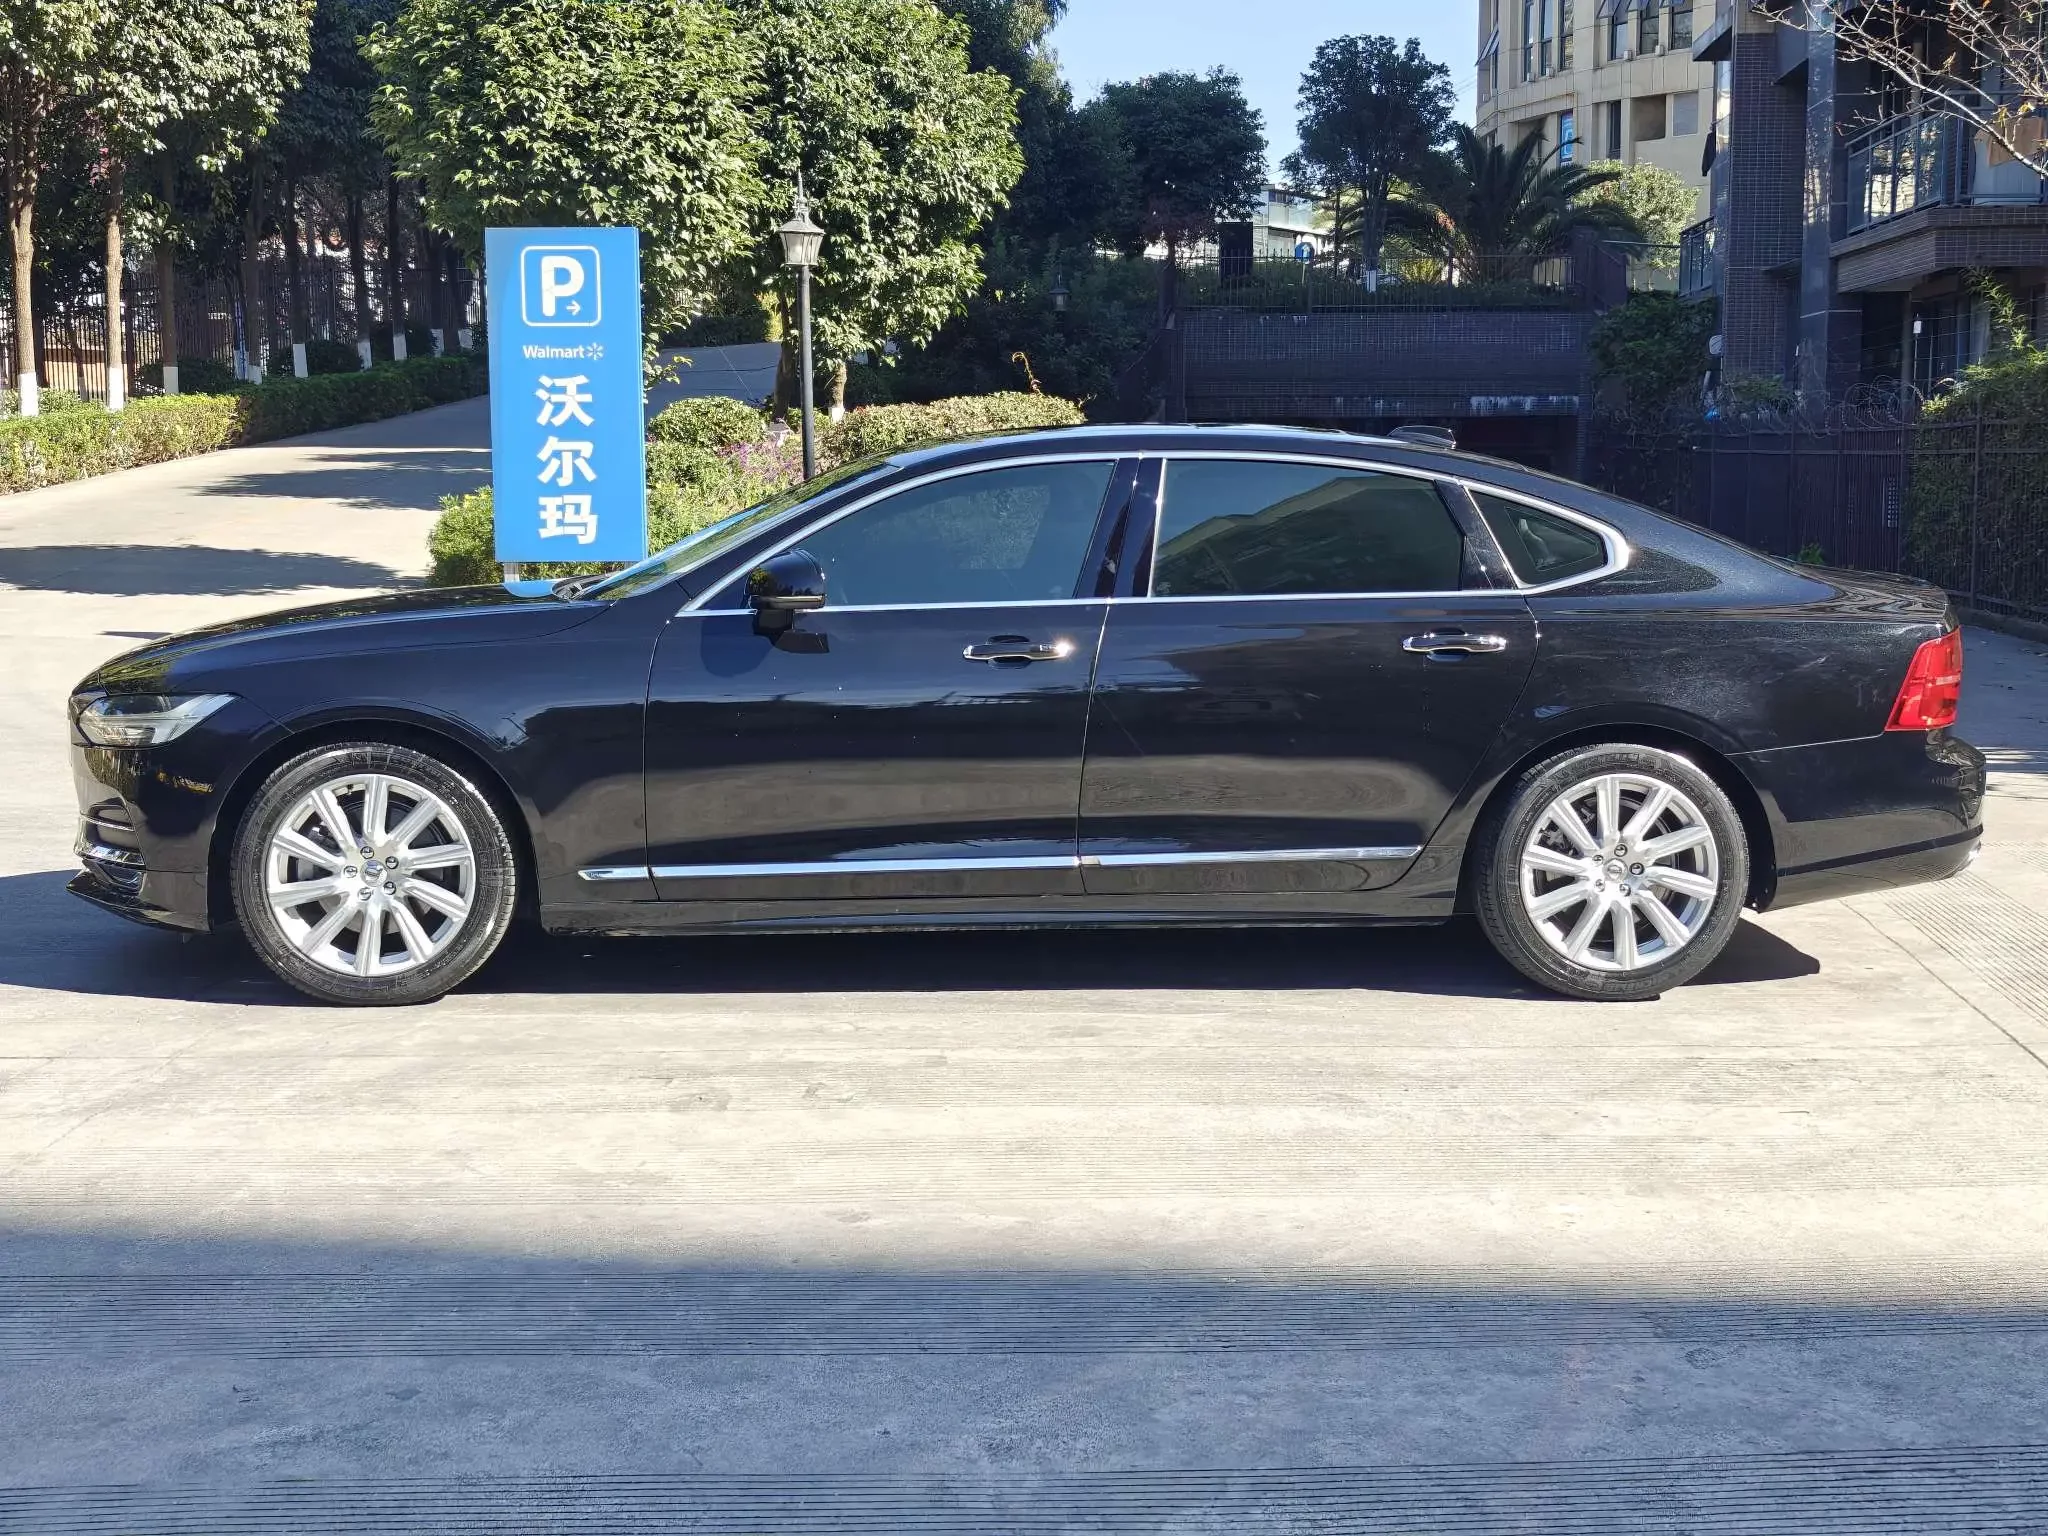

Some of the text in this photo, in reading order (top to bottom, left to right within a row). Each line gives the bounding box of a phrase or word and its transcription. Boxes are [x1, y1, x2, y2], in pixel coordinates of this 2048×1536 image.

[541, 255, 585, 317] P
[522, 344, 585, 359] Walmart
[536, 375, 598, 545] 沃尔玛
